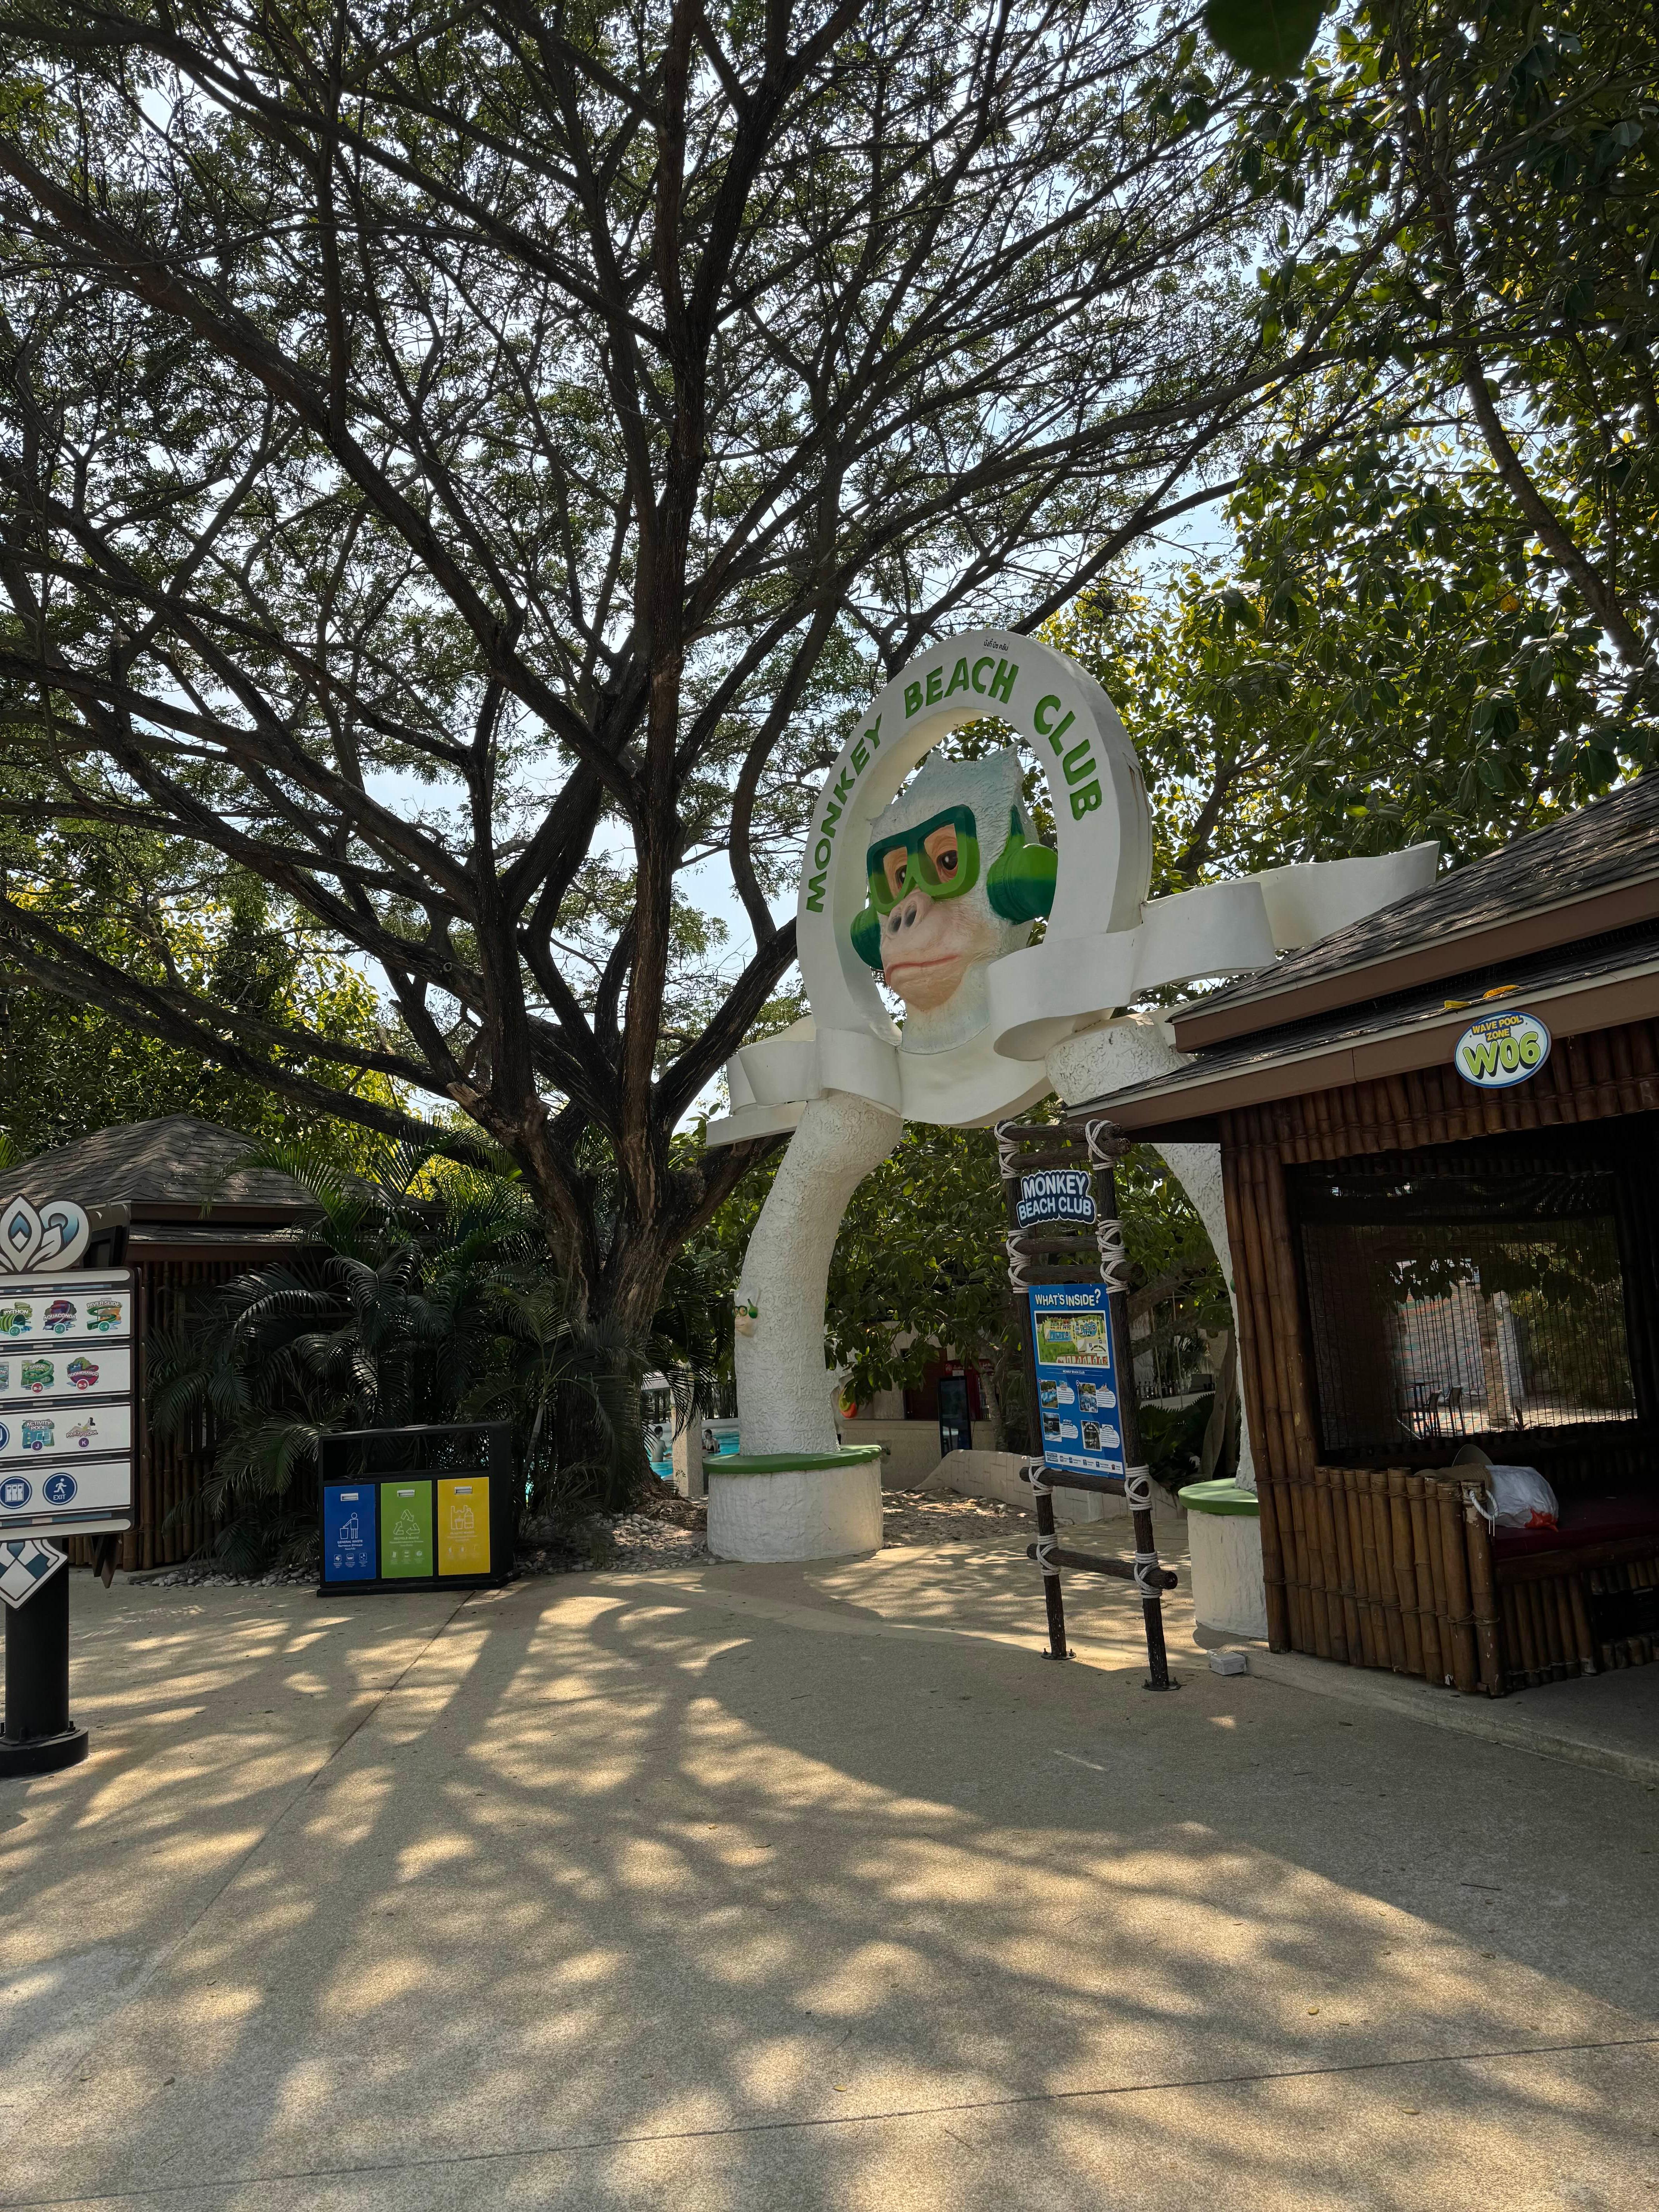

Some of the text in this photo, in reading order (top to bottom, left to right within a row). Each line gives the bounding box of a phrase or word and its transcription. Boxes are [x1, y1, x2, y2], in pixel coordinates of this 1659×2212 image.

[806, 656, 1103, 913] MONKEY BEACH CLUB
[1472, 1016, 1522, 1033] WAVE POOL
[1486, 1028, 1510, 1041] ZONE
[1463, 1032, 1541, 1077] W06
[1023, 1174, 1086, 1199] MONKEY
[1018, 1196, 1092, 1220] BEACH CLUB
[1035, 1288, 1101, 1307] WHAT'S INSIDE?
